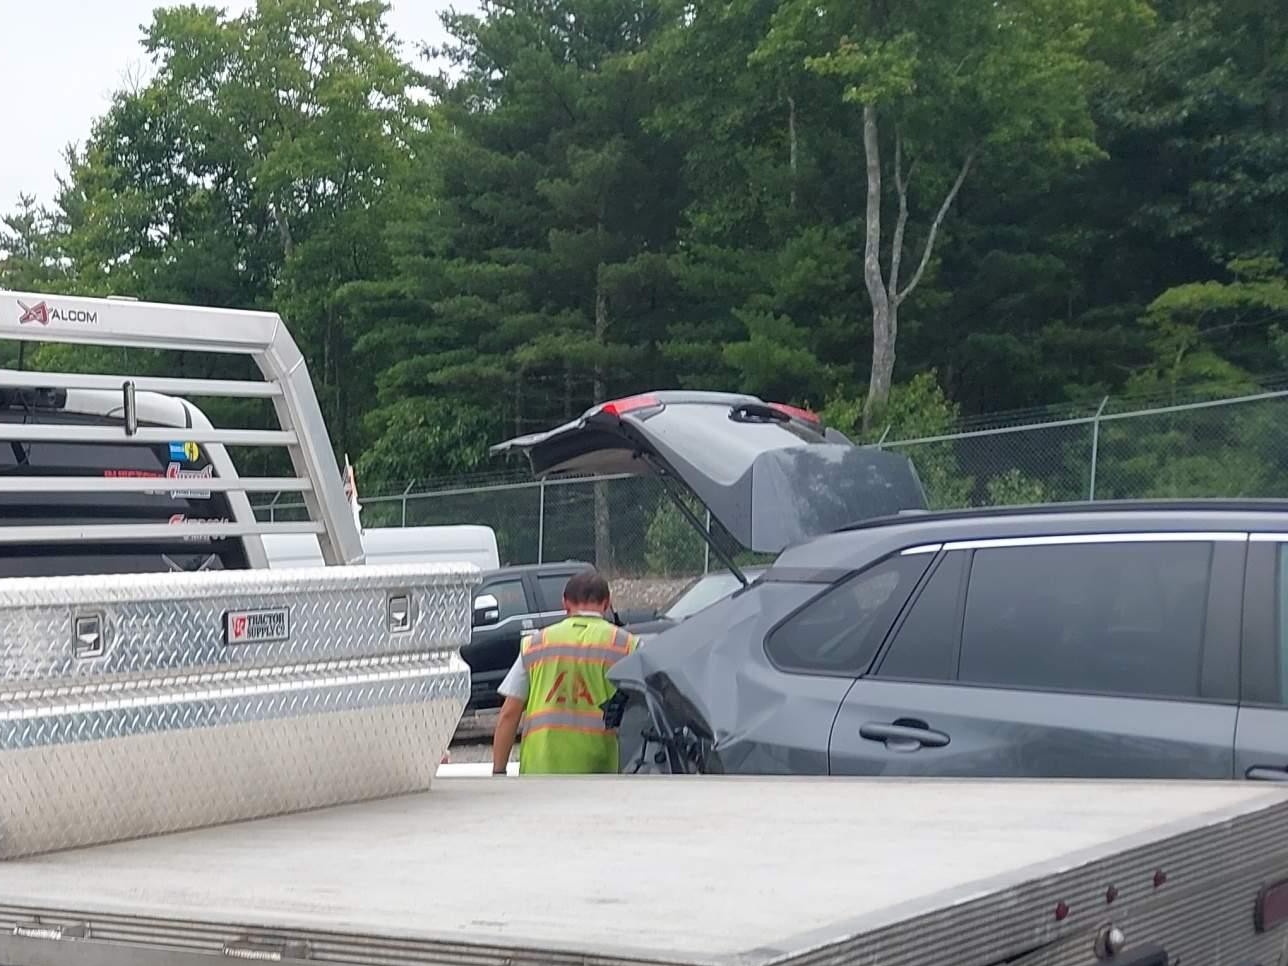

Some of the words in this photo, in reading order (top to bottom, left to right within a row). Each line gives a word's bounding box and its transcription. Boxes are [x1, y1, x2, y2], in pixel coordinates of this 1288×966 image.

[52, 309, 98, 325] ALCOM
[247, 612, 285, 625] TRACTOR
[247, 624, 276, 639] SUPPLY
